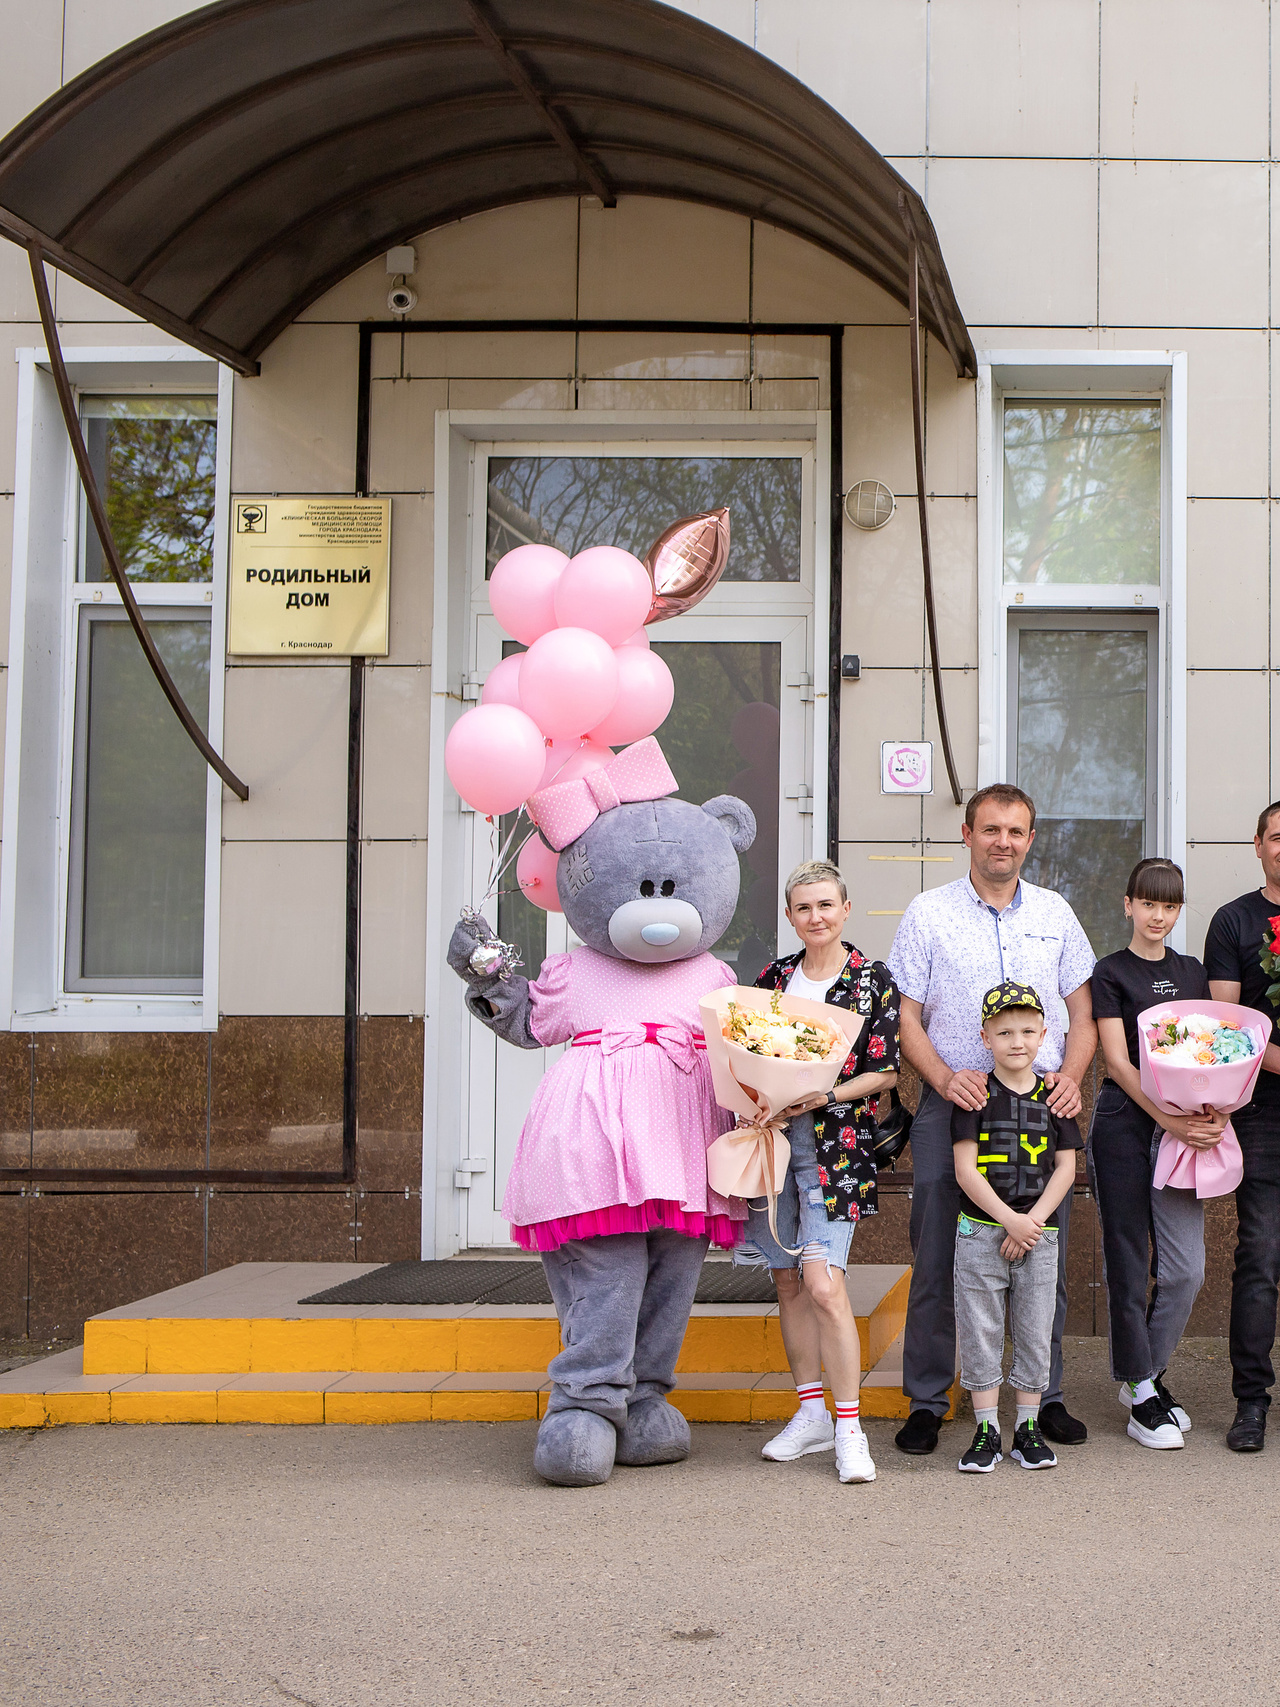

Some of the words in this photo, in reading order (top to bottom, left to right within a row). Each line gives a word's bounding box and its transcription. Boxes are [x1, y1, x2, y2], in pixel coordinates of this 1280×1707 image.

[245, 565, 371, 586] РОДИЛЬНЫЙ
[285, 592, 330, 610] ДОМ
[288, 641, 333, 649] Краснодар
